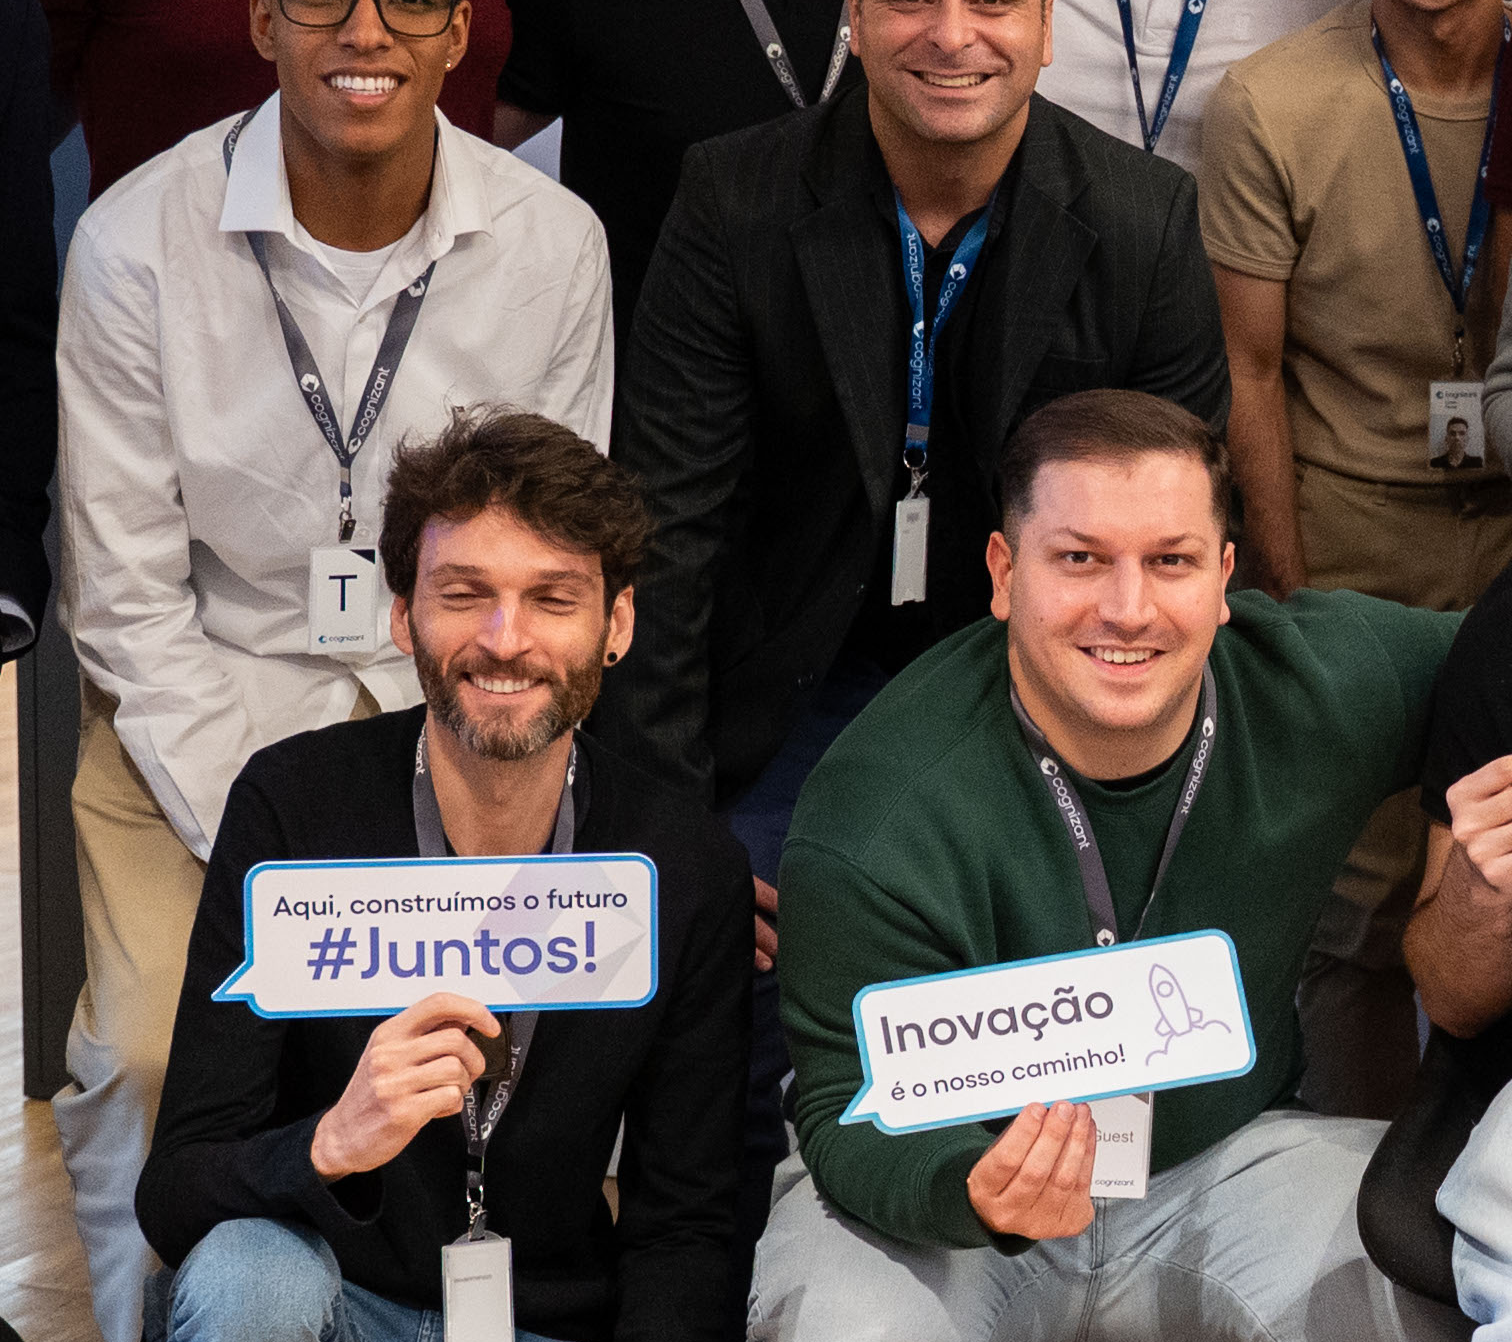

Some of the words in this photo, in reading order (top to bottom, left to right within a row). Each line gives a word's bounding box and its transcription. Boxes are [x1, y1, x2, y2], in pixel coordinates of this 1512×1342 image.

[1395, 95, 1420, 156] cognizant
[357, 366, 391, 436] cognizant
[909, 340, 924, 410] cognizant
[328, 574, 358, 612] T
[328, 633, 365, 644] cognizant
[1180, 738, 1209, 815] cognizant
[1051, 776, 1091, 851] cognizant
[272, 894, 342, 921] Aqui,
[349, 891, 516, 915] construímos
[523, 894, 540, 910] o
[546, 888, 628, 910] futuro
[306, 920, 597, 981] #Juntos!
[880, 985, 1114, 1055] Inovação
[891, 1080, 905, 1101] é
[912, 1083, 927, 1097] o
[933, 1070, 1005, 1094] nosso
[1012, 1043, 1126, 1080] caminho!
[1095, 1179, 1135, 1188] cognizant
